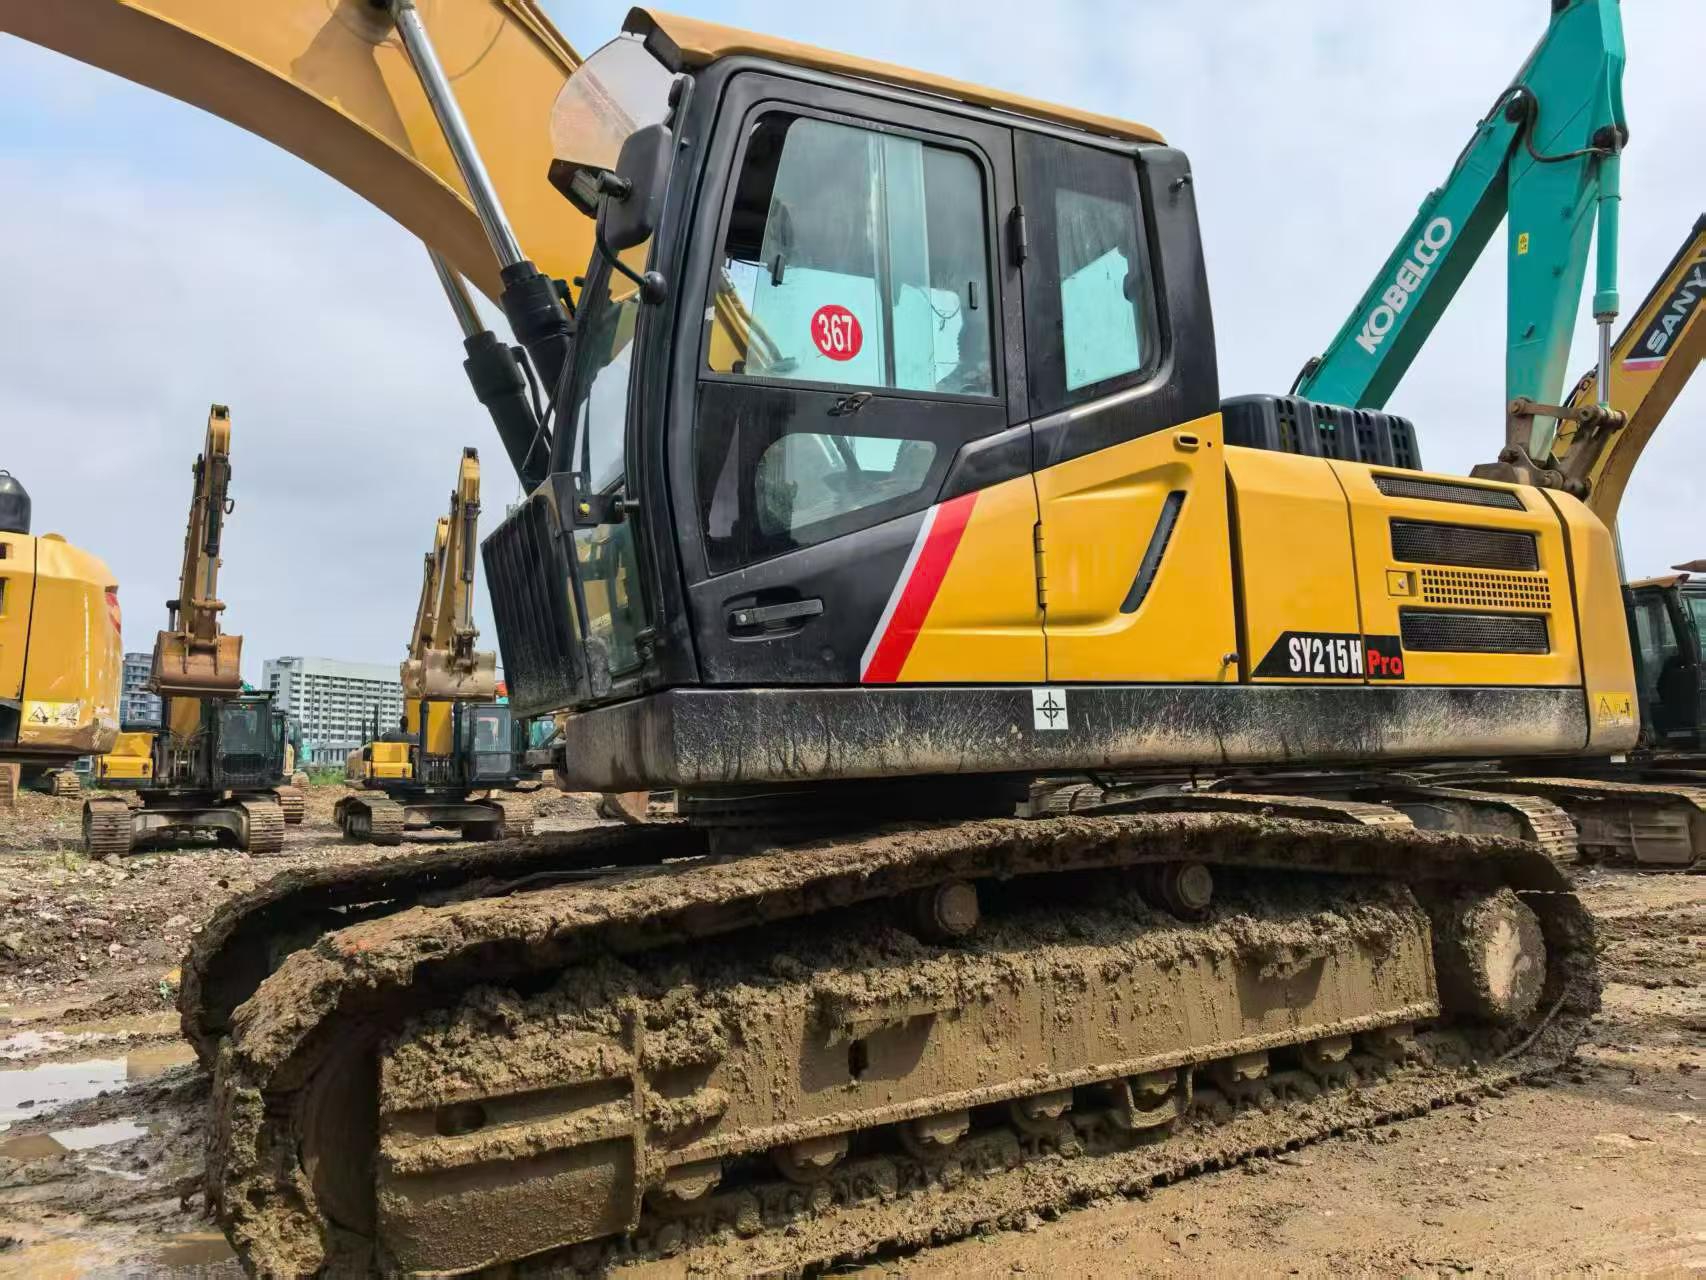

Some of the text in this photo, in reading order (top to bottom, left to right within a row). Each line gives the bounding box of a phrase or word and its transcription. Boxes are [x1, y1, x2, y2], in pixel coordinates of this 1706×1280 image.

[1355, 217, 1452, 355] KOBELCO
[1647, 267, 1706, 354] SANY
[818, 313, 852, 352] 367
[1288, 637, 1403, 675] SY215H Pro
